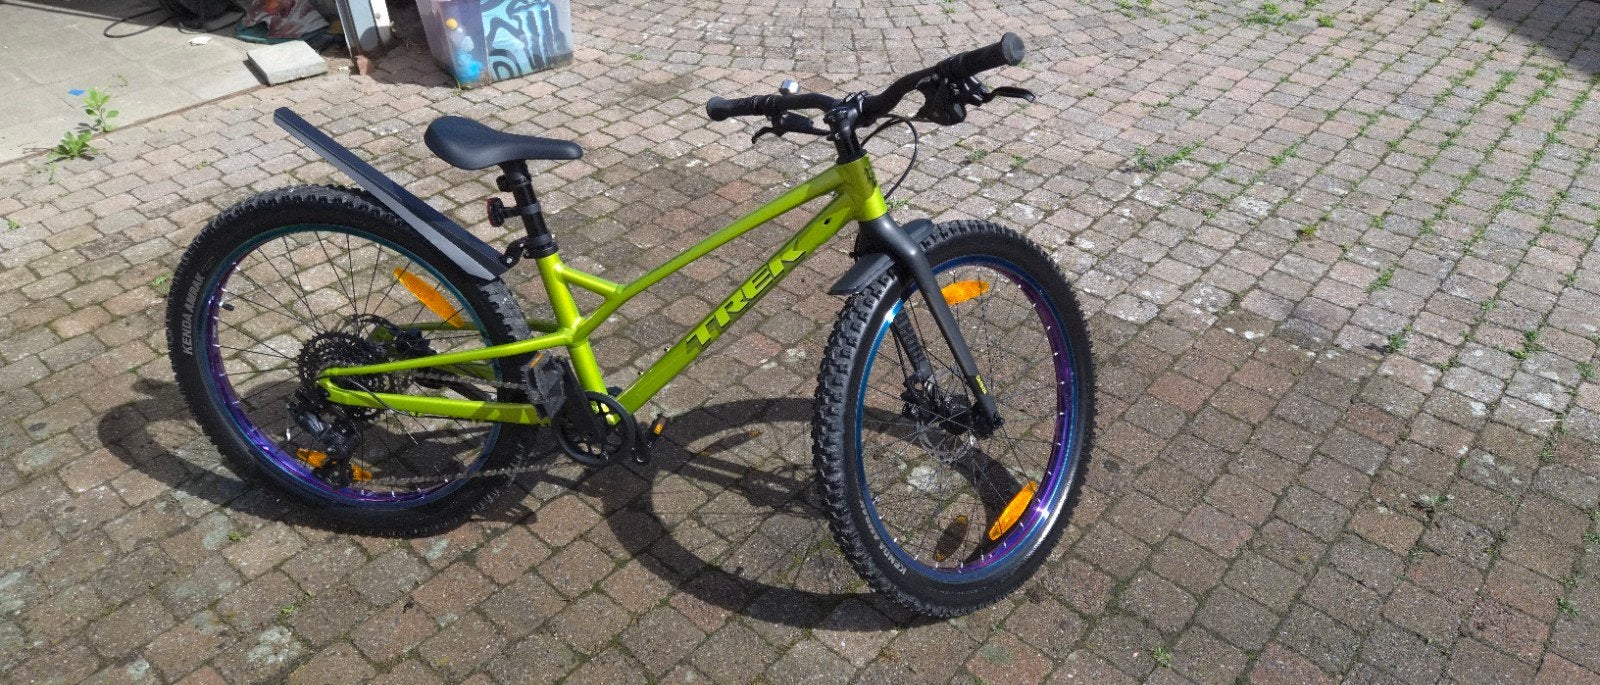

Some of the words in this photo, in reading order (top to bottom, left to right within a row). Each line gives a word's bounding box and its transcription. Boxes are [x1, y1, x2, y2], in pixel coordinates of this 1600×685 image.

[686, 238, 806, 346] TREK
[182, 313, 193, 355] KENDA
[879, 541, 907, 575] KENDA
